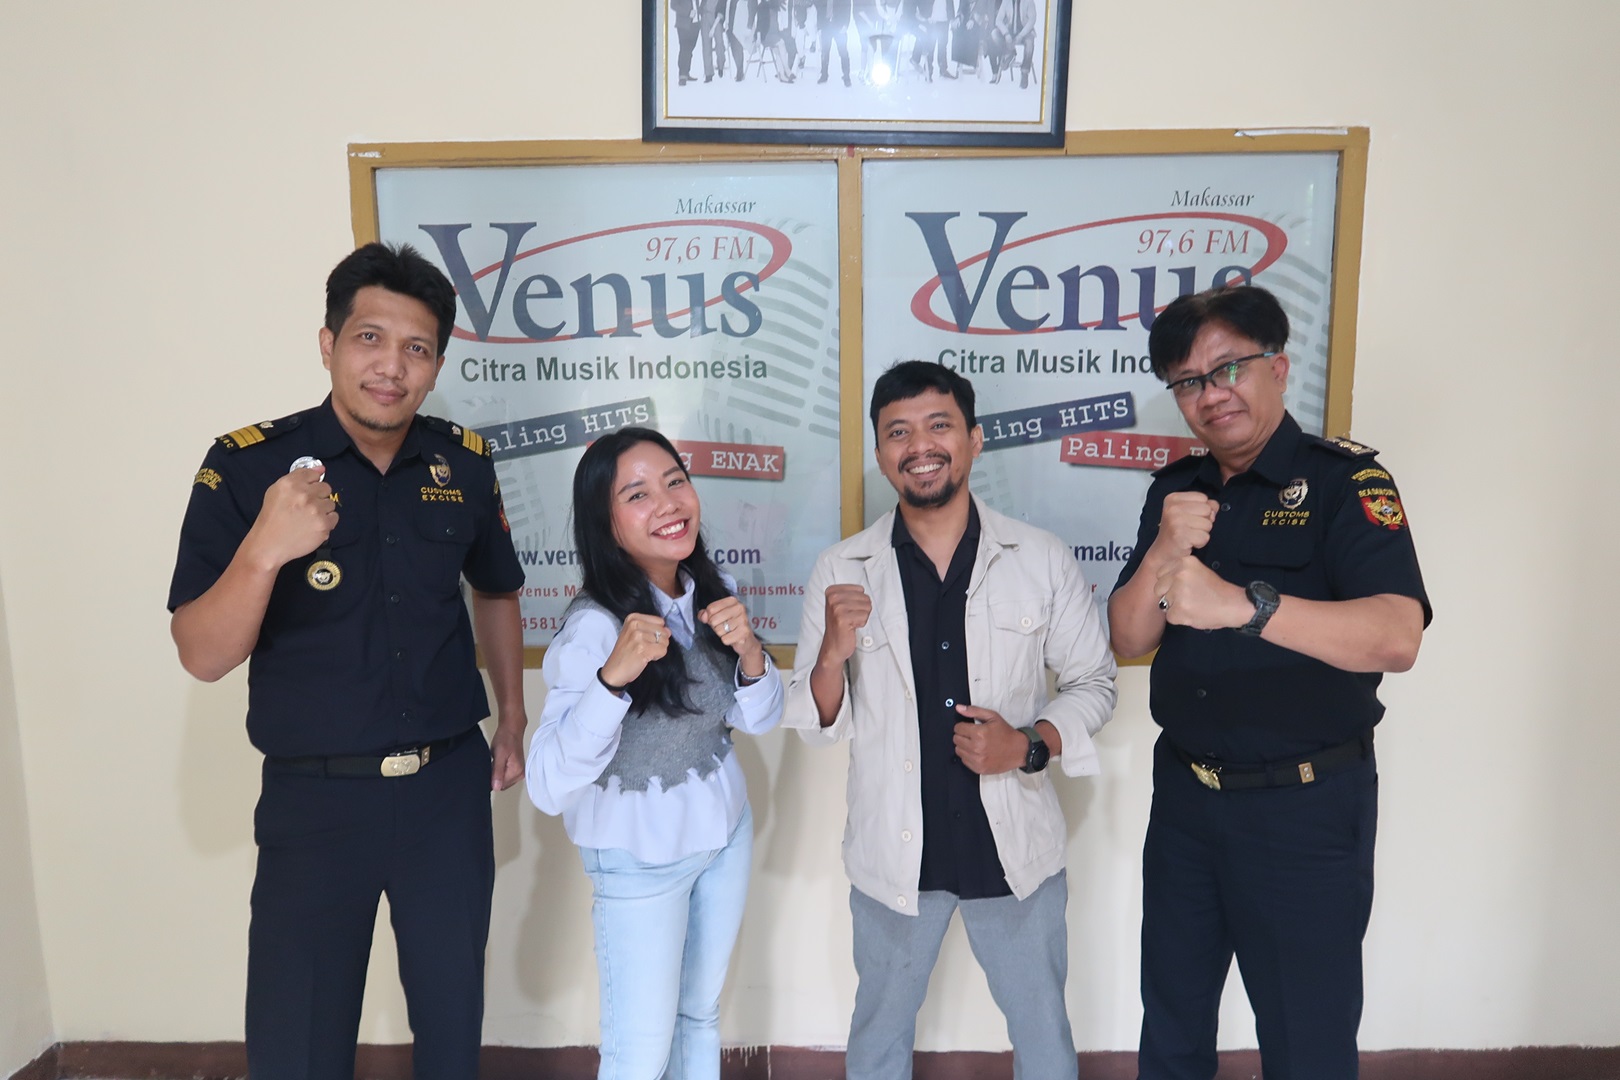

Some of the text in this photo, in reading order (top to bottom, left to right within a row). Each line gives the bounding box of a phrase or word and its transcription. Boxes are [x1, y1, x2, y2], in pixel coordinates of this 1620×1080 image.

[675, 194, 757, 214] Makassar
[1170, 188, 1254, 207] Makassar
[646, 236, 755, 265] 97,6 FM
[1137, 229, 1250, 257] 97,6 FM
[418, 221, 763, 342] Venus
[460, 354, 768, 382] Citra Musik Indonesia
[938, 349, 1005, 373] Citra
[1016, 349, 1102, 373] Musik
[489, 423, 567, 453] aling
[580, 403, 650, 434] HITS
[981, 397, 1129, 442] ling HITS
[711, 450, 780, 473] ENAK
[1066, 437, 1170, 467] Paling
[420, 486, 462, 496] CUSTOMS
[421, 494, 464, 503] EXCISE
[1262, 518, 1306, 526] EXCISE
[1264, 510, 1310, 519] CUSTOMS
